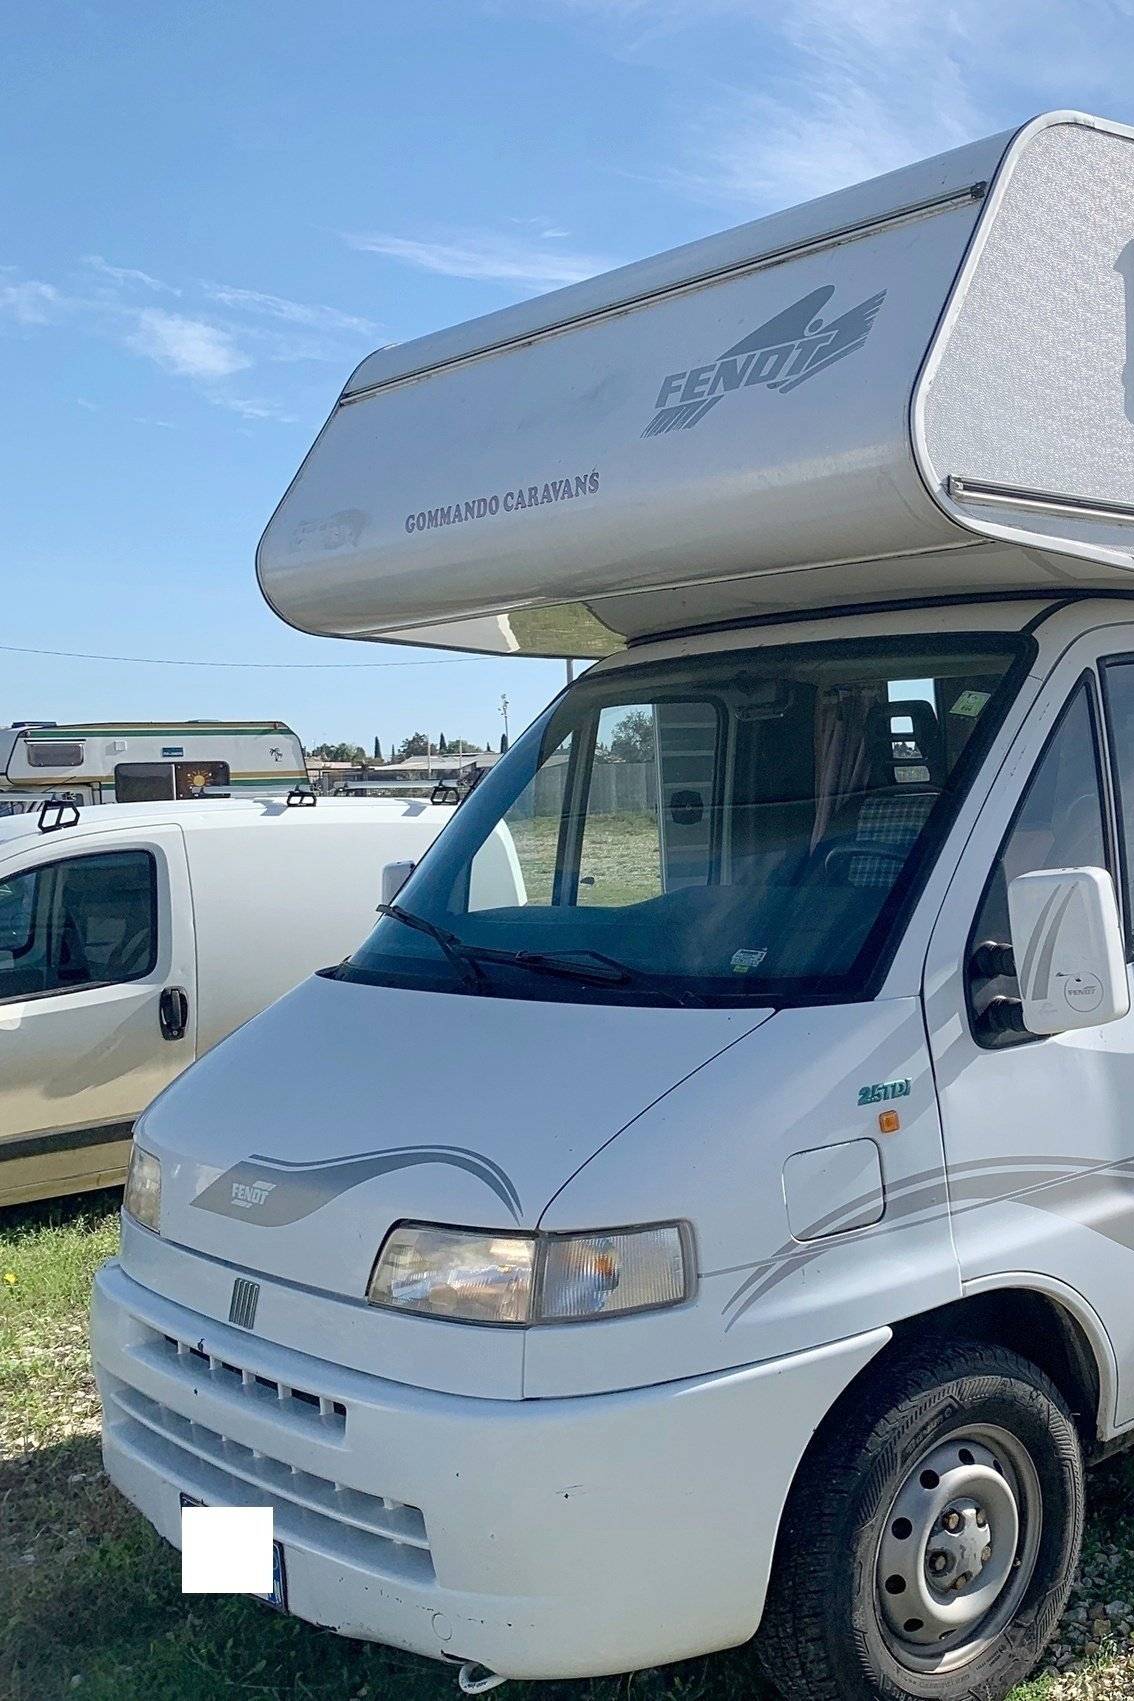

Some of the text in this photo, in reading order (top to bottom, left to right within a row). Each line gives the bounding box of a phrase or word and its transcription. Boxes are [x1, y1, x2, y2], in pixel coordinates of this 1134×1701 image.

[655, 330, 839, 409] FENDT
[503, 471, 600, 512] CARAVANS
[232, 1183, 269, 1205] FENDT
